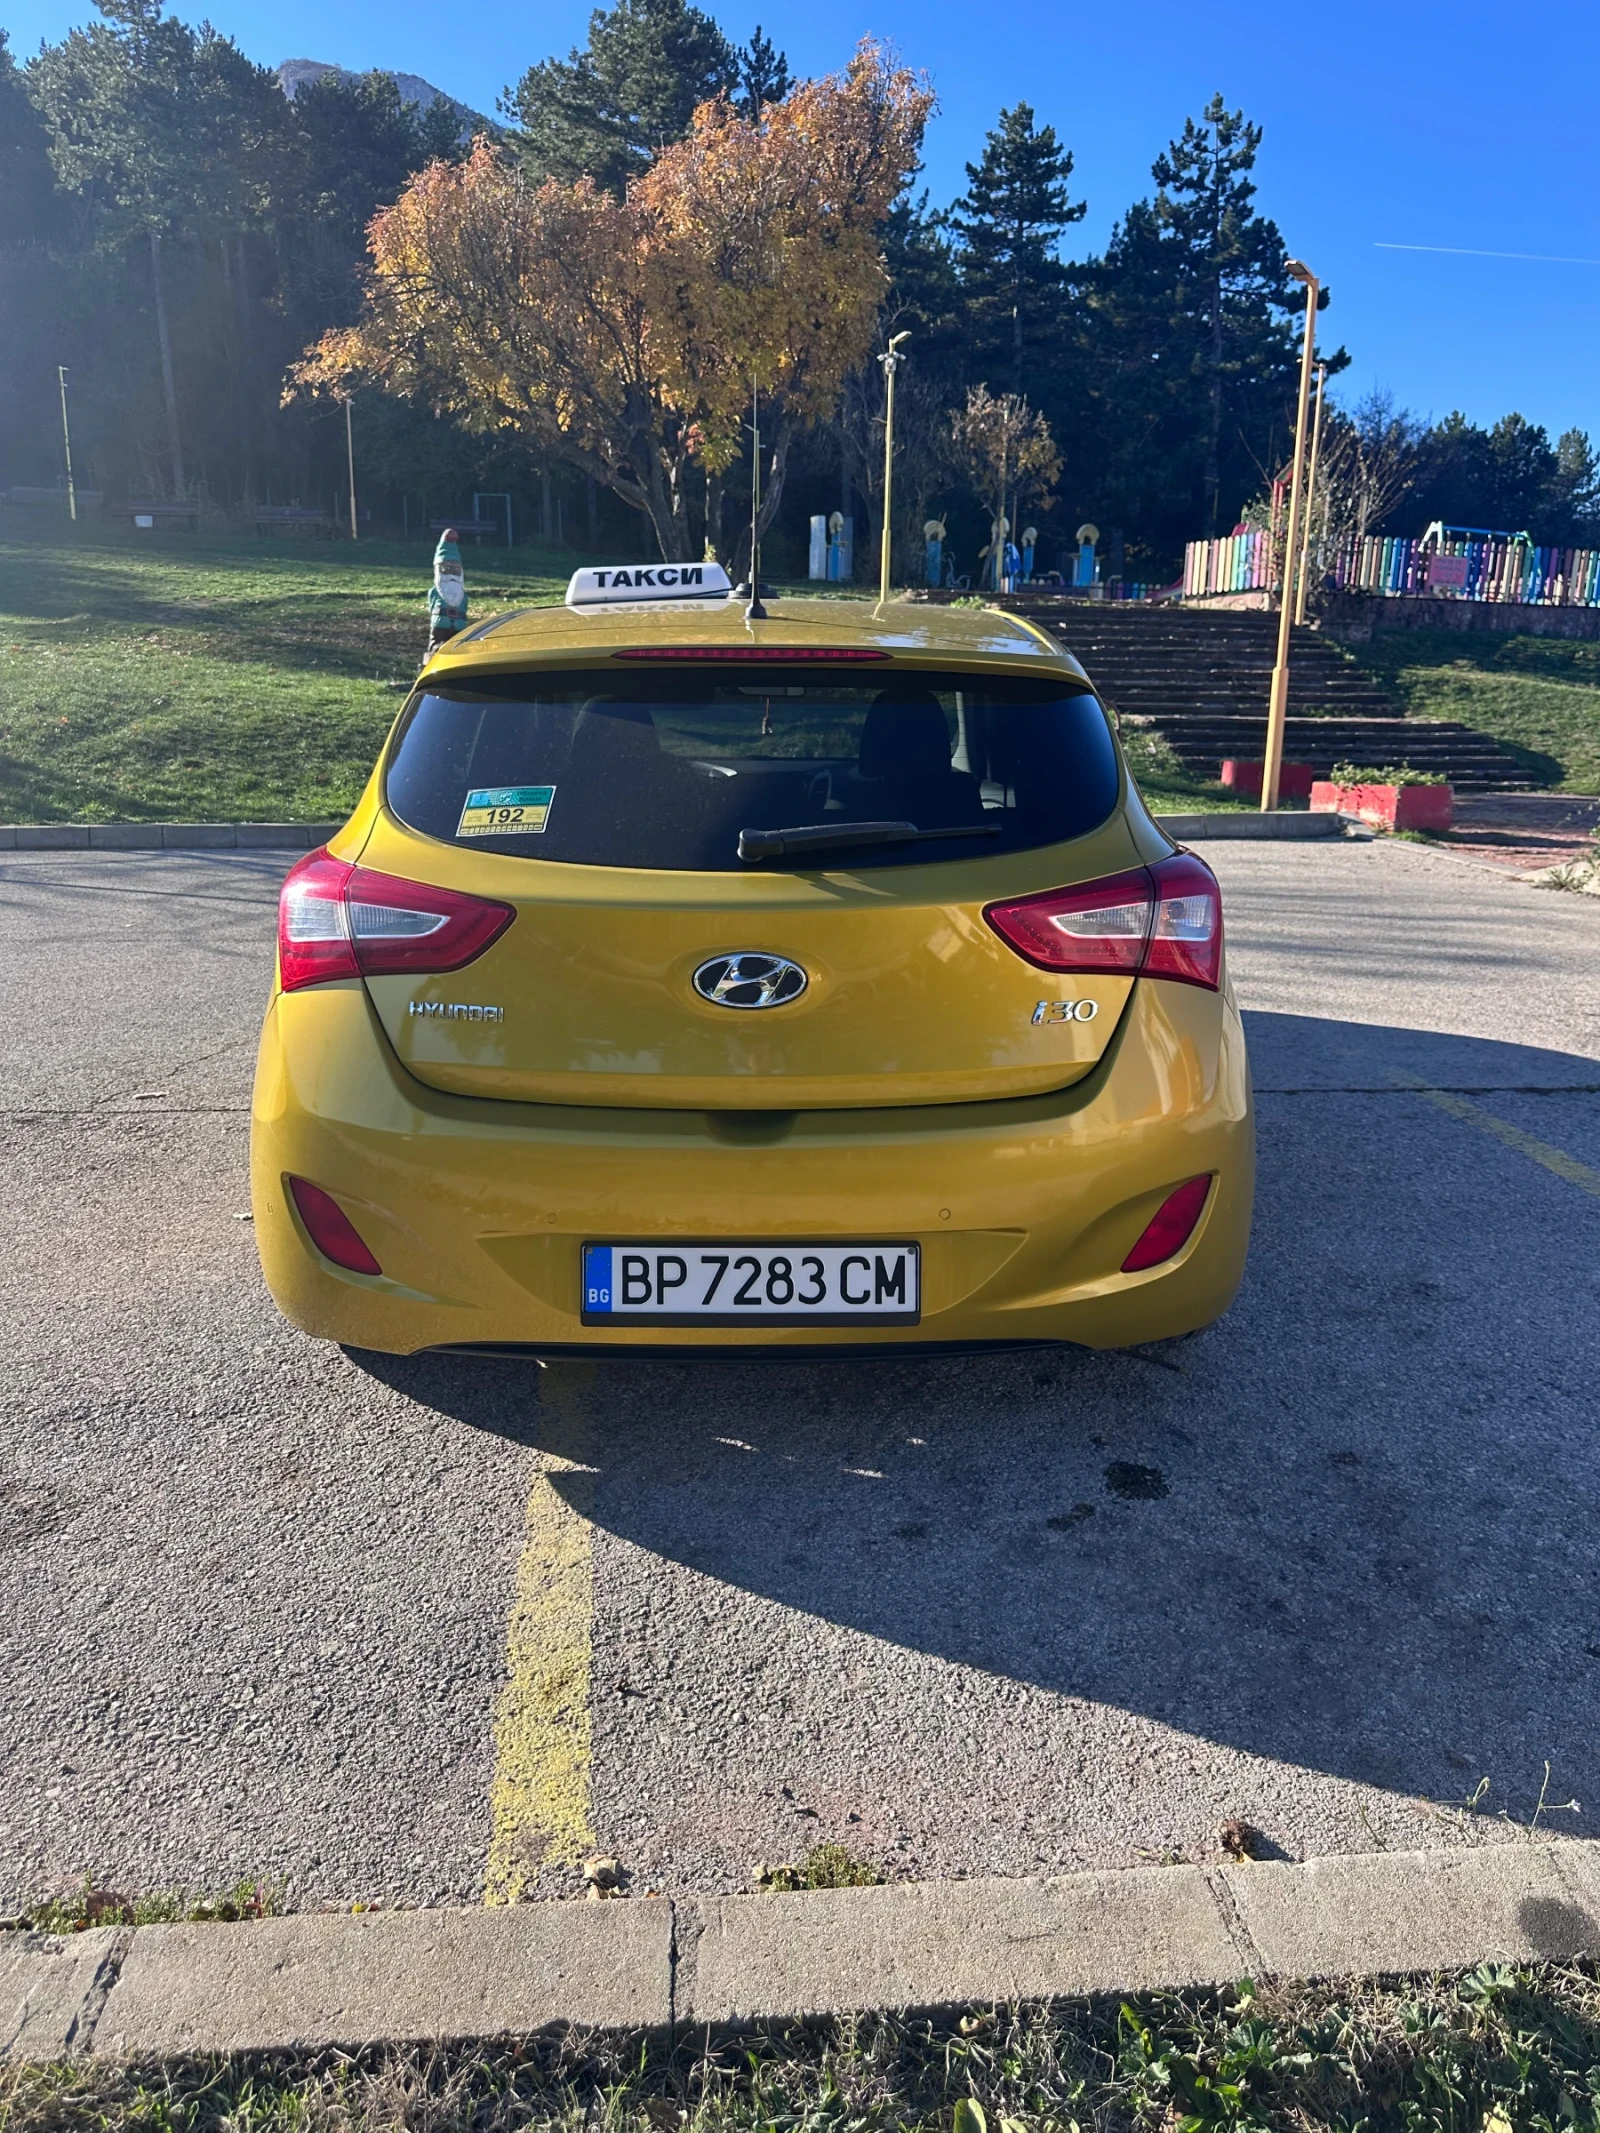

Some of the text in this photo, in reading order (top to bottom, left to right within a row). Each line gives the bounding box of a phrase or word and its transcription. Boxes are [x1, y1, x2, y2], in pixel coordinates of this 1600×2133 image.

[593, 568, 703, 588] ТАКСИ
[487, 808, 525, 824] 192
[409, 1001, 504, 1023] HYUNDAI
[1031, 999, 1098, 1026] i30
[621, 1255, 906, 1306] BP 7283 CM
[588, 1288, 610, 1304] BG
